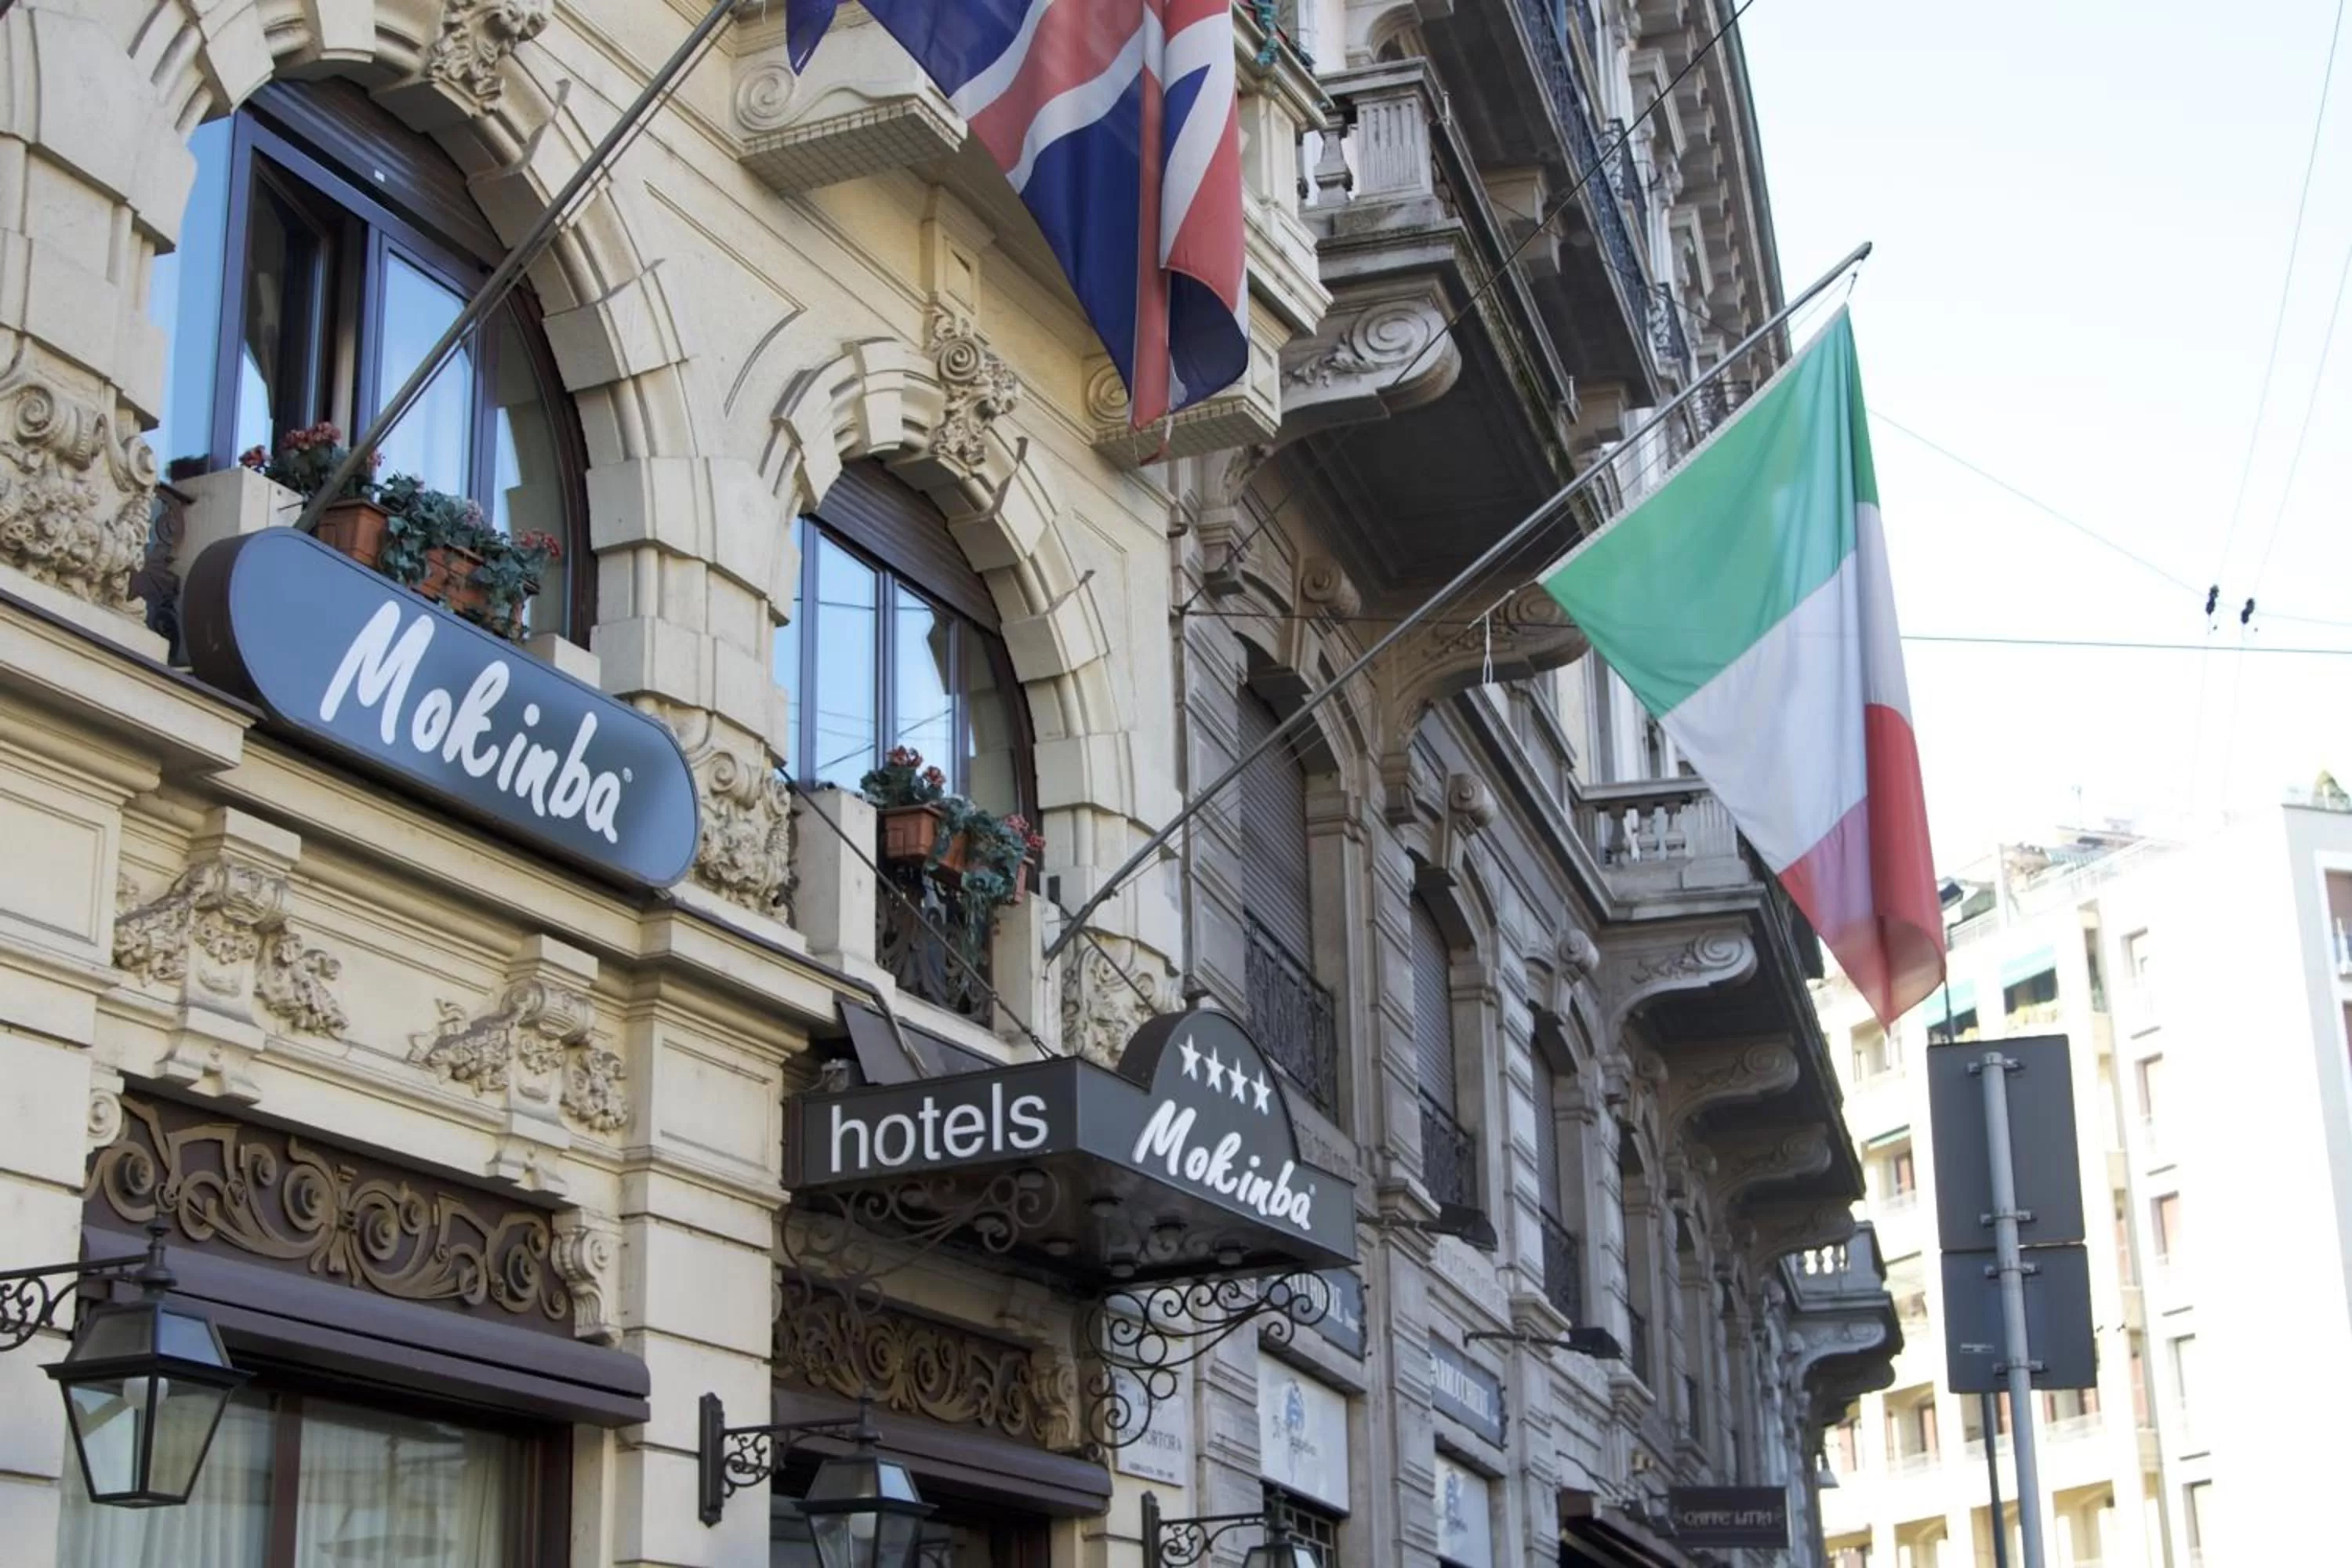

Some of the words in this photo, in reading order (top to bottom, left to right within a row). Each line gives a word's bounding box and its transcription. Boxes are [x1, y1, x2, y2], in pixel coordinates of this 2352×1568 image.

[320, 600, 621, 843] Mokinba
[831, 1083, 1049, 1172] hotels
[1134, 1100, 1312, 1231] Mokinba
